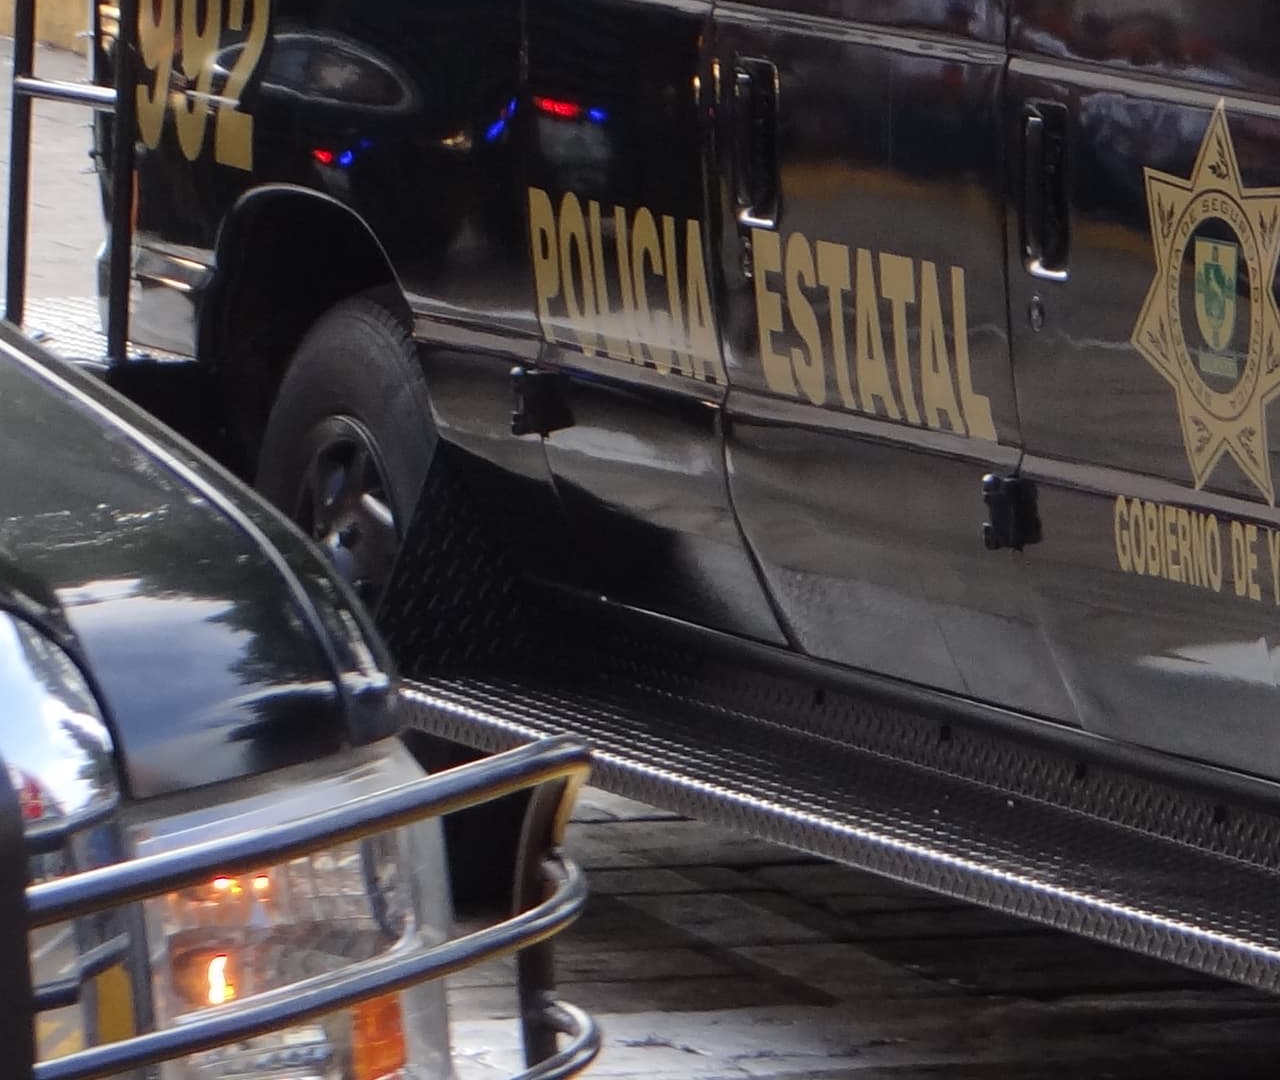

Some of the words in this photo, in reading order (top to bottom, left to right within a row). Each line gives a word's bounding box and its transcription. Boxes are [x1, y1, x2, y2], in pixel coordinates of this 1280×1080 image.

[528, 186, 728, 385] POLICIA
[751, 228, 998, 442] ESTATAL
[1114, 494, 1222, 593] GOBIERNO
[1230, 519, 1262, 601] DE
